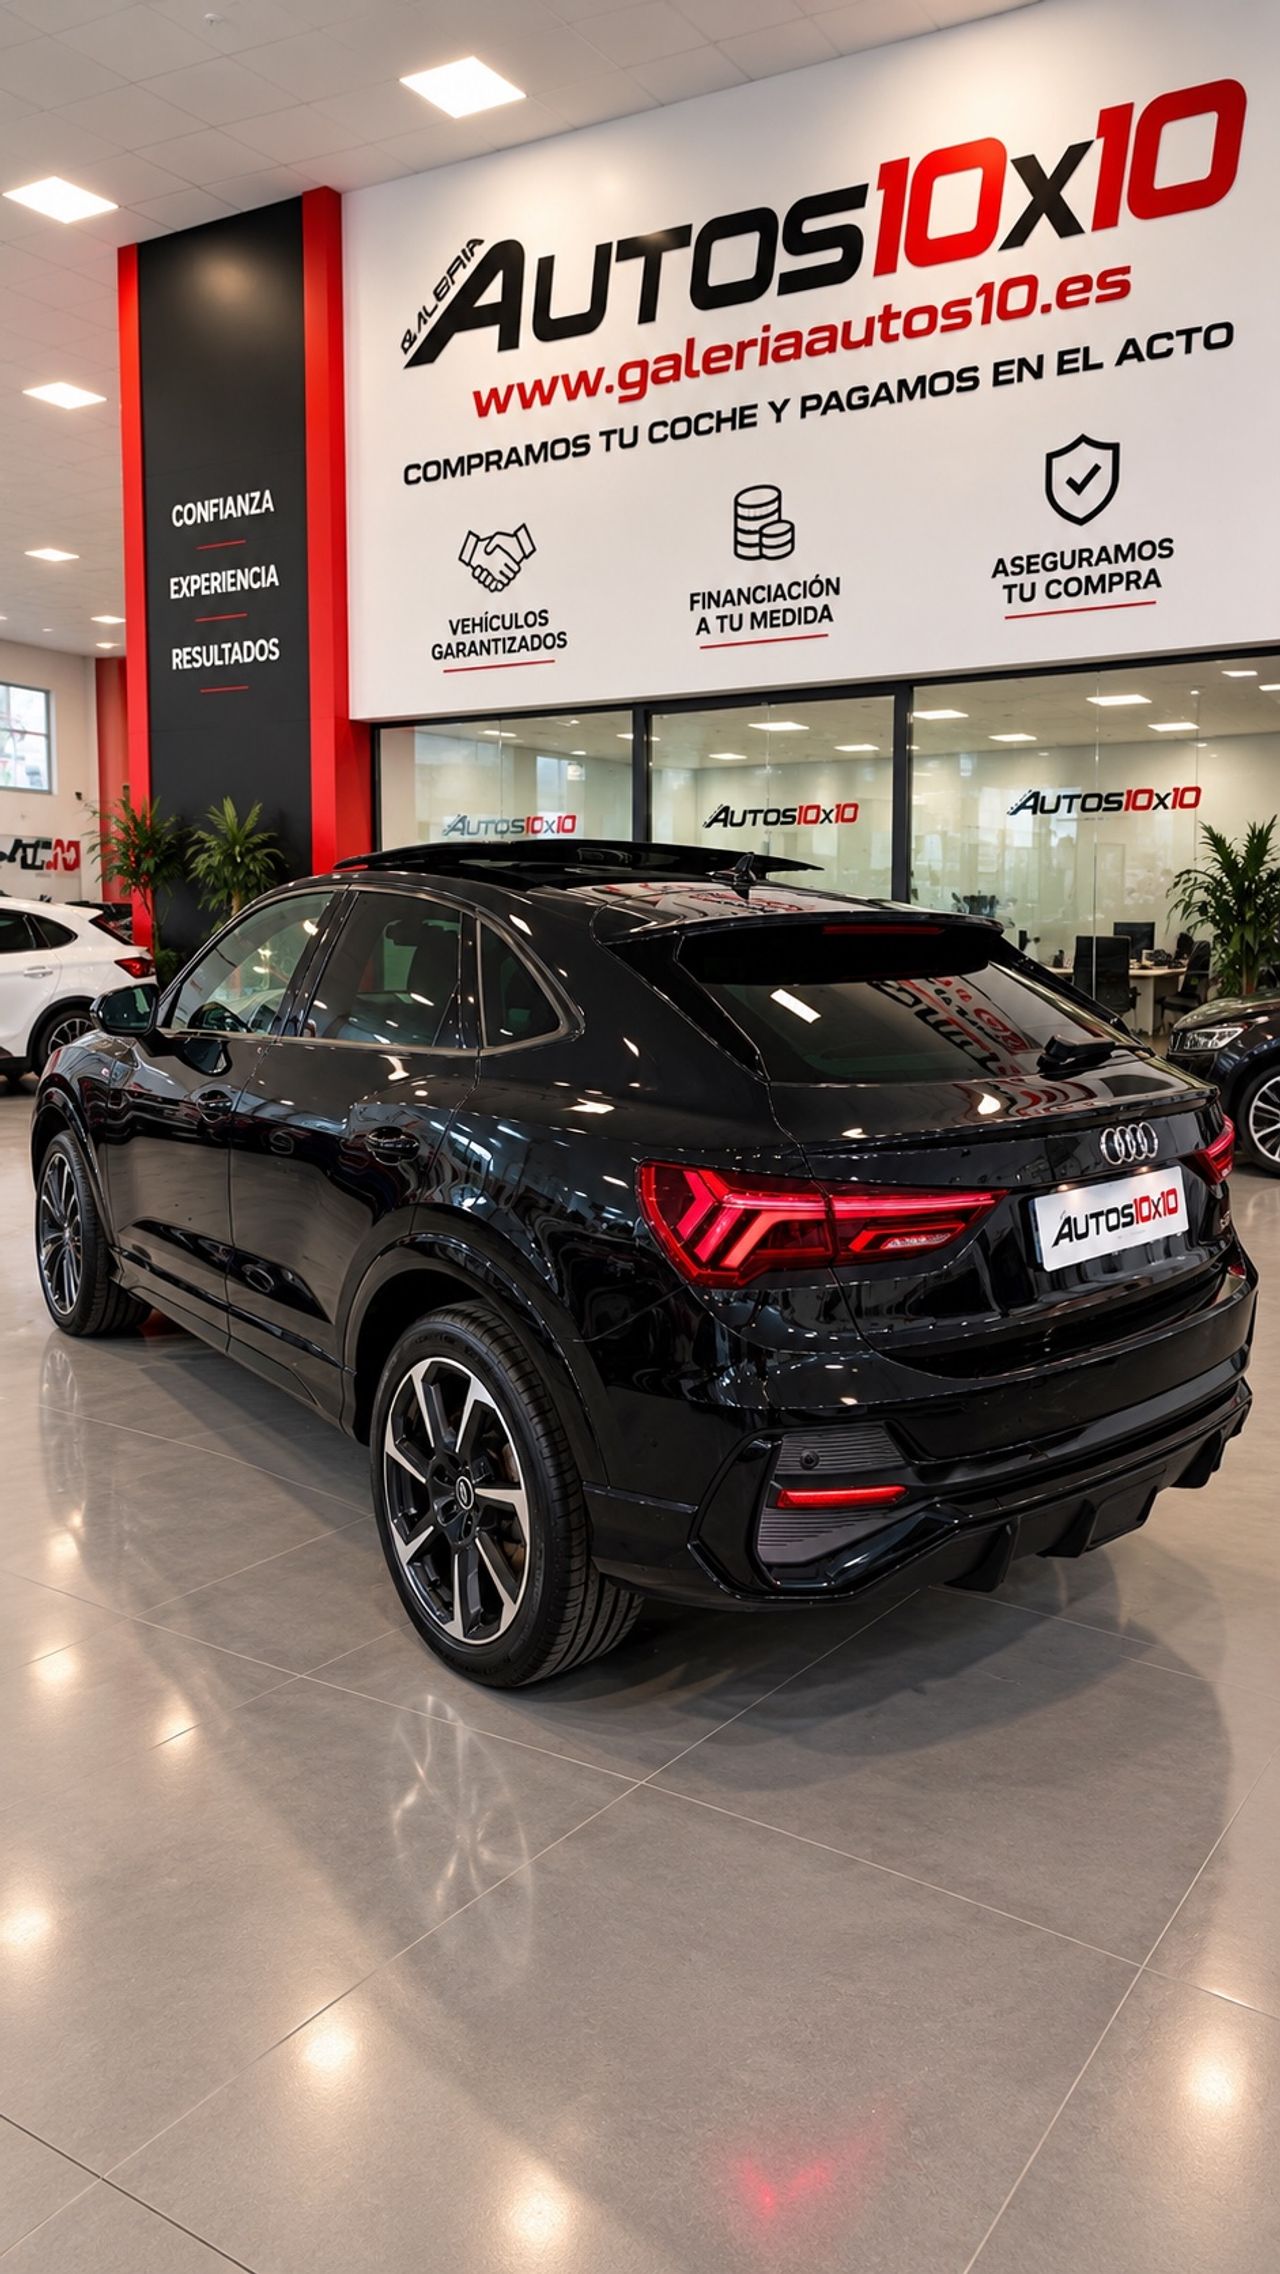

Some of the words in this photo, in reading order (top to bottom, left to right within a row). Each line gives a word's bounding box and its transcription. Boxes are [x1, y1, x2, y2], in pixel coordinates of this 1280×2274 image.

[472, 265, 1132, 418] www.galeriaautos10.es
[403, 433, 591, 486] COMPRAMOS
[598, 425, 639, 453] TU
[647, 403, 759, 445] COCHE
[767, 397, 791, 424] Y
[799, 365, 980, 420] PAGAMOS
[992, 353, 1045, 388] EN
[1056, 345, 1104, 377] EL
[1114, 321, 1234, 367] ACTO
[171, 489, 275, 528] CONFIANZA
[991, 537, 1174, 579] ASEGURAMOS
[169, 564, 280, 600] EXPERIENCIA
[689, 573, 841, 612] FINANCIACIÓN
[1002, 581, 1037, 604] TU
[1044, 567, 1162, 600] COMPRA
[448, 608, 549, 636] VEHÍCULOS
[695, 616, 711, 636] A
[715, 612, 744, 634] TU
[750, 603, 834, 631] MEDIDA
[171, 637, 280, 670] RESULTADOS
[431, 631, 568, 661] GARANTIZADOS
